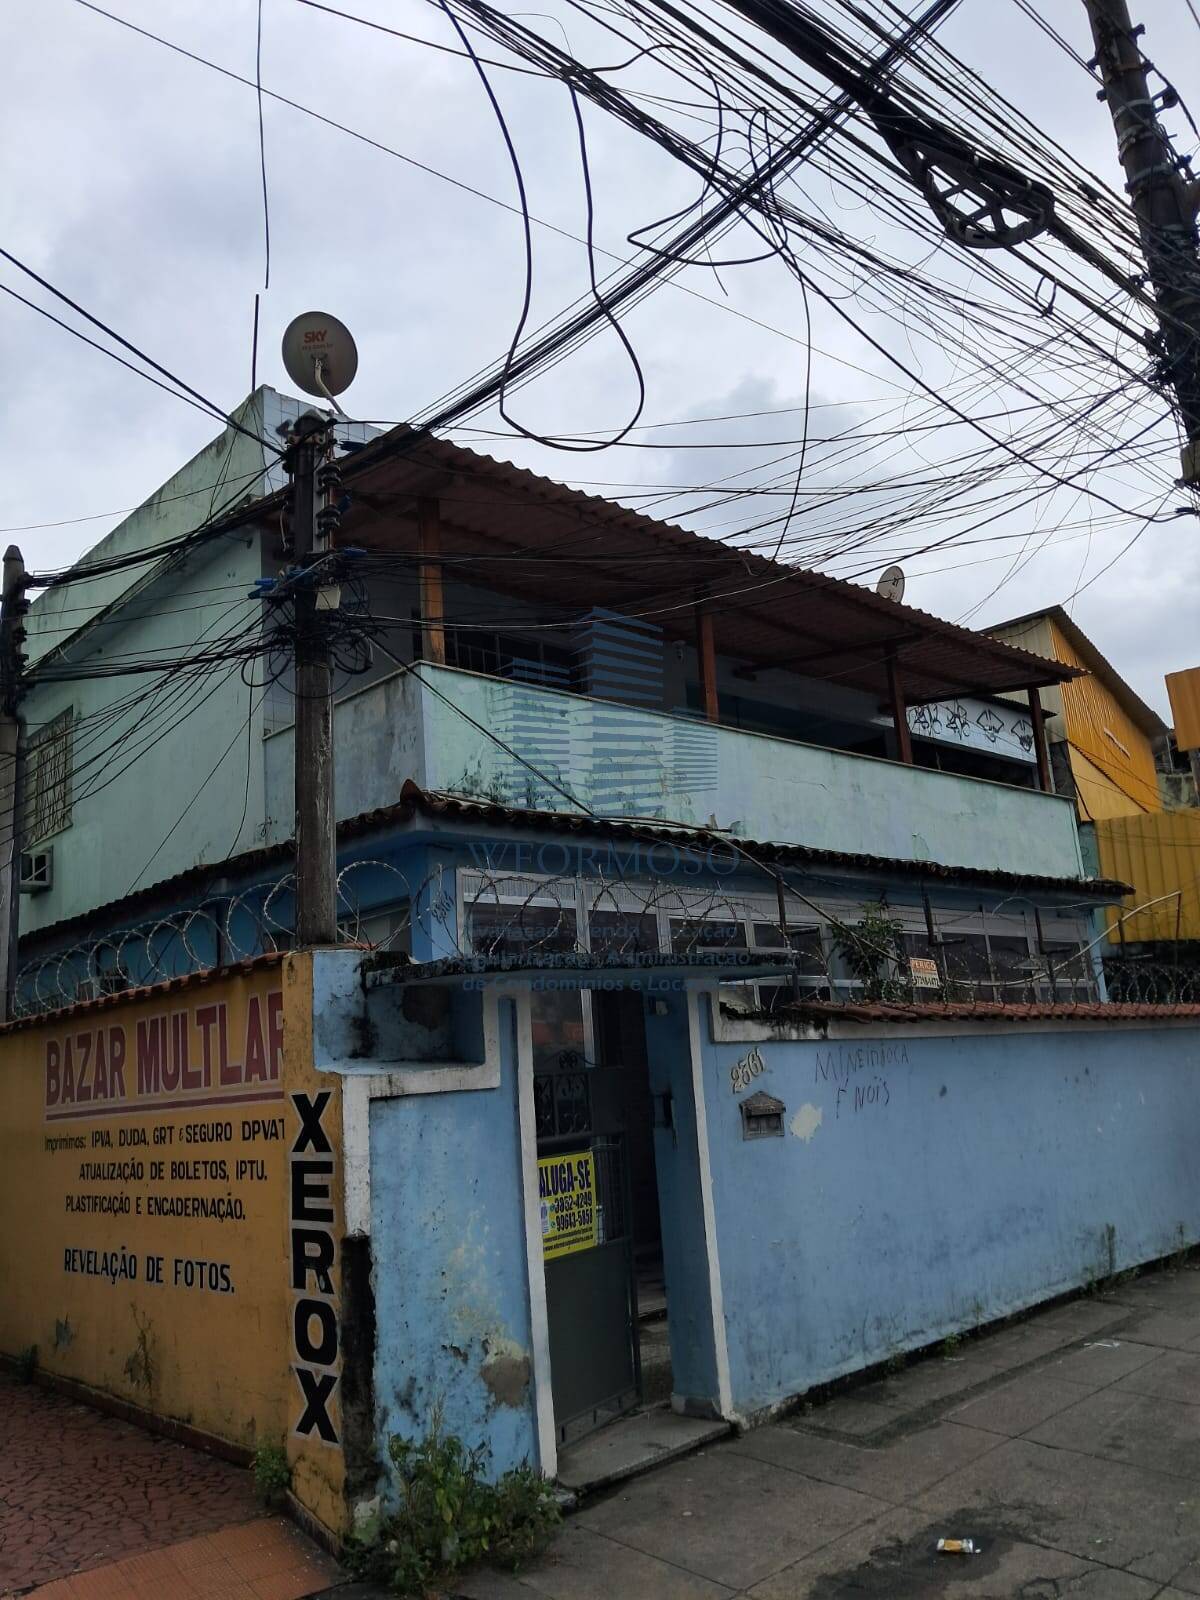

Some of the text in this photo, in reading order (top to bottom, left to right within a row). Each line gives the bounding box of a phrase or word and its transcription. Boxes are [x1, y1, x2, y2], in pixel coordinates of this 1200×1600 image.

[303, 329, 328, 344] SKY
[45, 1025, 126, 1107] BAZAR
[91, 1130, 114, 1150] IPVA,
[118, 1127, 150, 1147] DUDA,
[153, 1125, 175, 1145] GRT
[185, 1121, 233, 1144] SEGURO
[79, 1157, 268, 1184] ATUALIZAÇÃO DE BOLETOS, IPTU.
[539, 1158, 592, 1199] ALUGA-SE
[65, 1191, 246, 1224] PLASTIFICAÇÃO E ENCADERNAÇÃO.
[64, 1245, 235, 1294] REVELAÇÃO DE FOTOS.
[290, 1090, 340, 1445] XEROX
